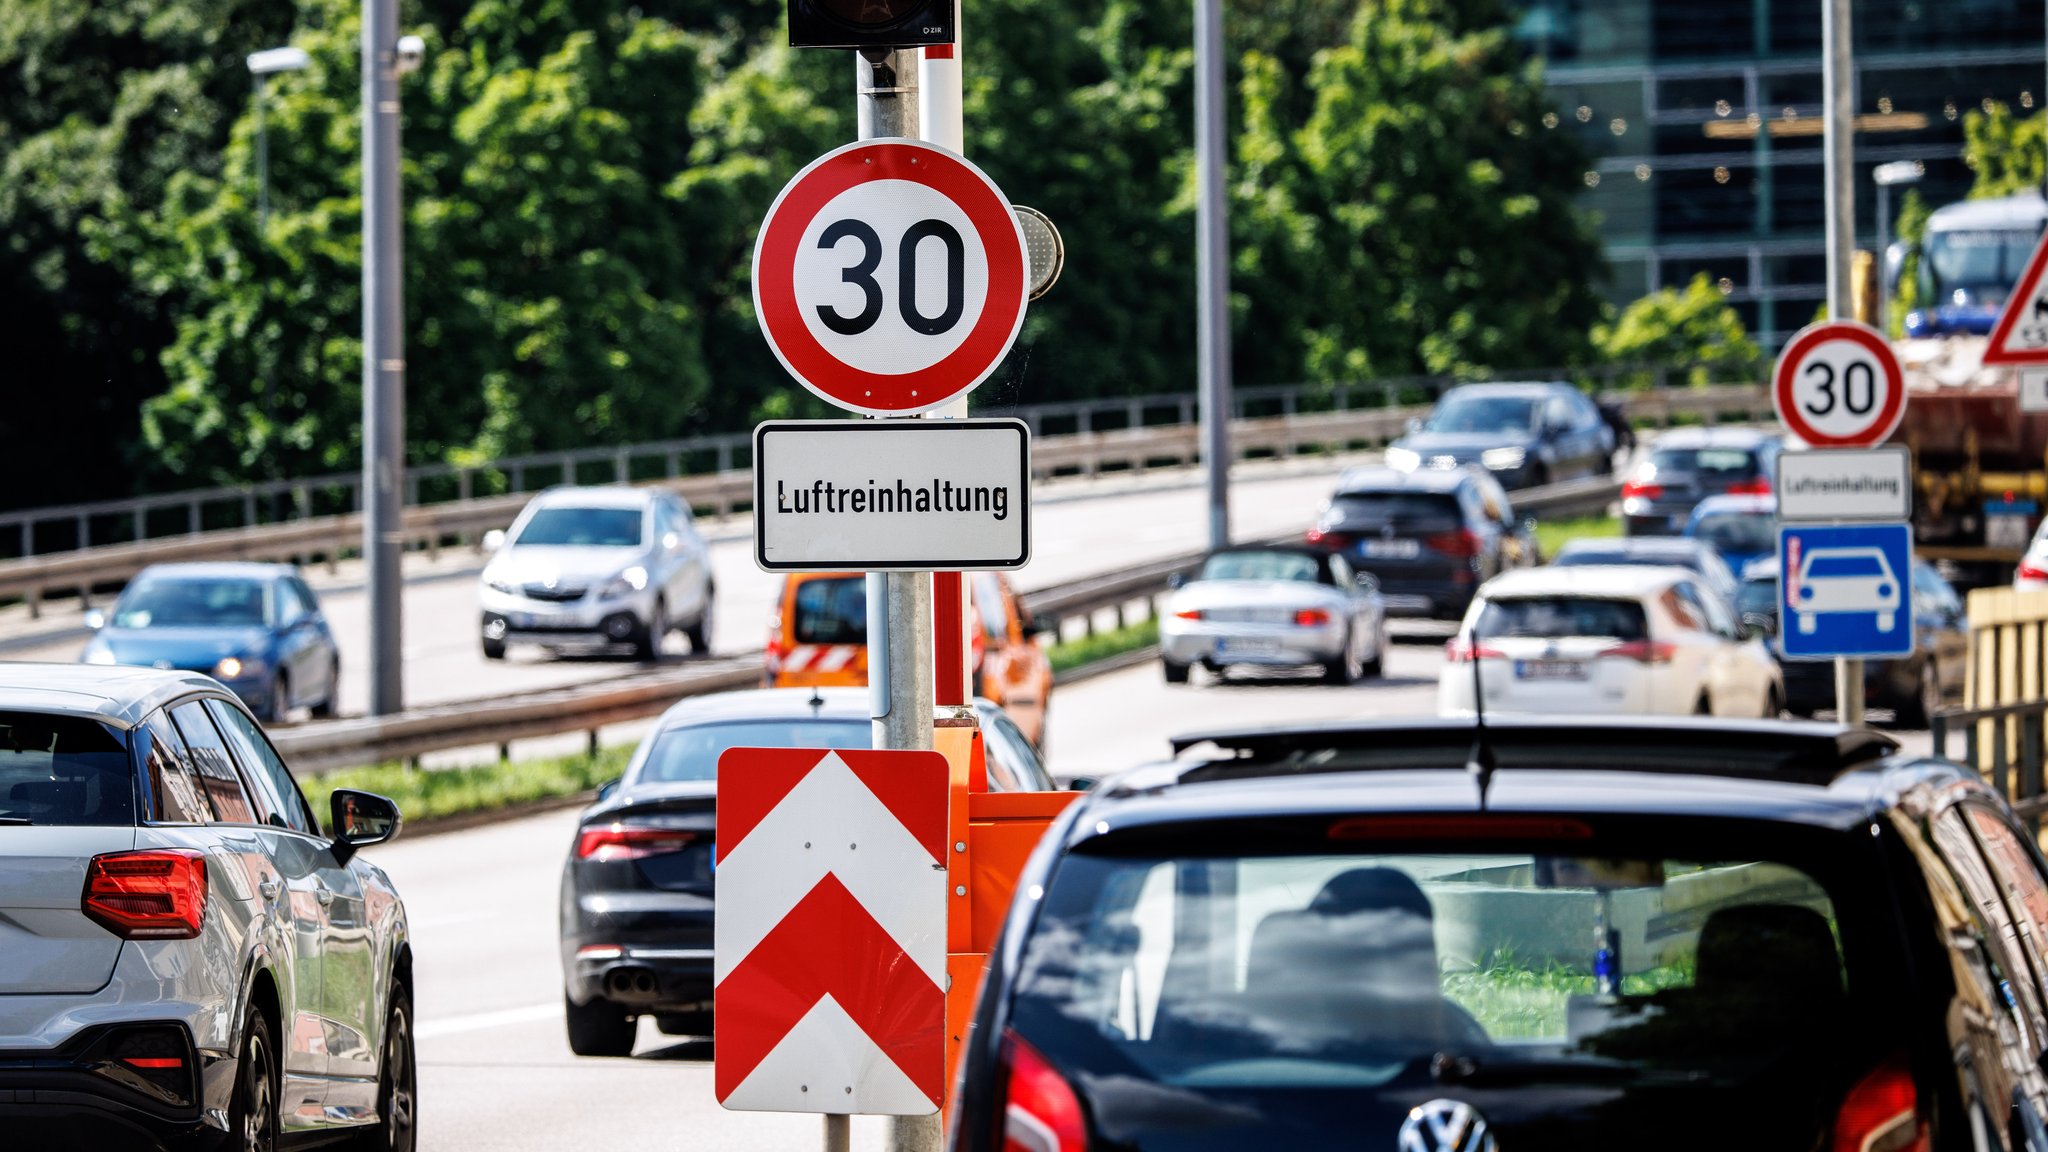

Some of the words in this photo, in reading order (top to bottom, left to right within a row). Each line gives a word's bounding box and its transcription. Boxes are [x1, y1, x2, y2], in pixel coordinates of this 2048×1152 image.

[815, 218, 965, 336] 30
[1804, 361, 1875, 416] 30
[777, 478, 1009, 521] Luftreinhaltung
[1785, 475, 1898, 498] Luftreinhaltung
